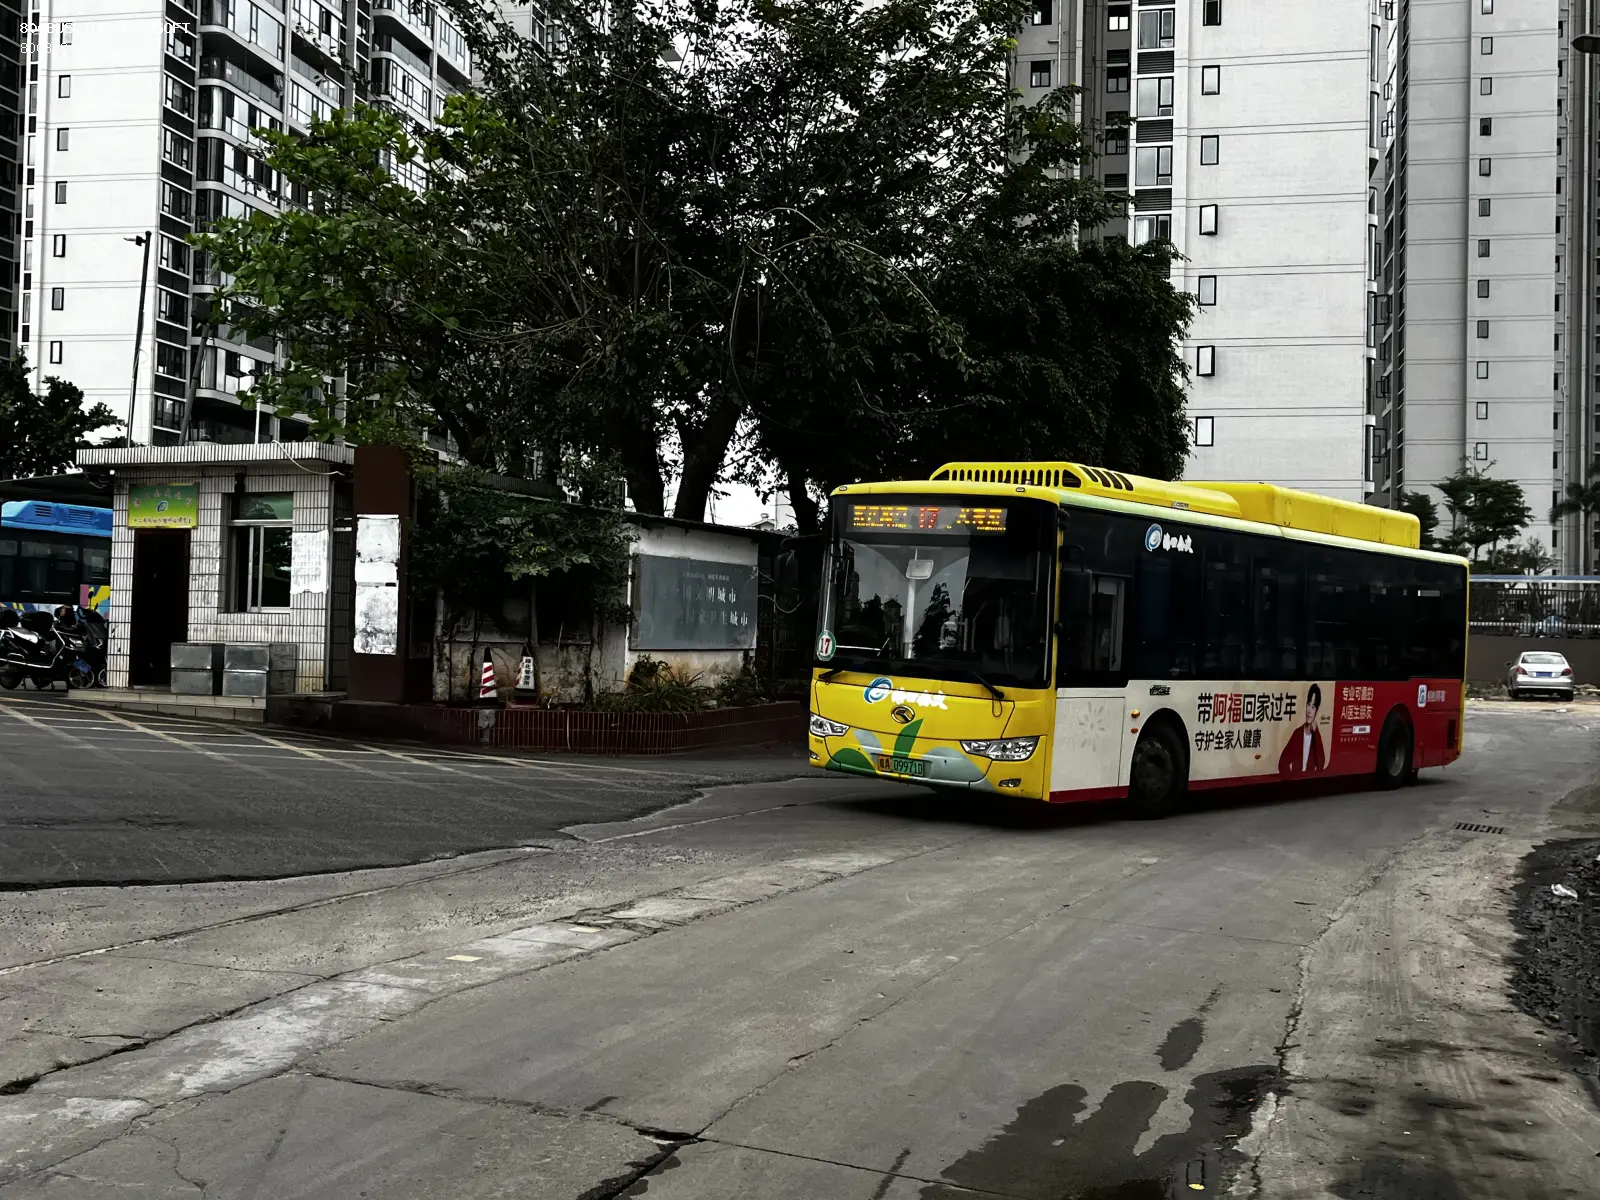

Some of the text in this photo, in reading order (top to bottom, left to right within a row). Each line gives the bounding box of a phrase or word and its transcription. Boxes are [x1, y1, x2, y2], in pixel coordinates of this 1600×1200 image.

[919, 507, 941, 529] 17
[819, 637, 831, 654] 17
[1198, 692, 1297, 724] 带阿福回家过年
[1195, 728, 1262, 751] 守护全家人健康
